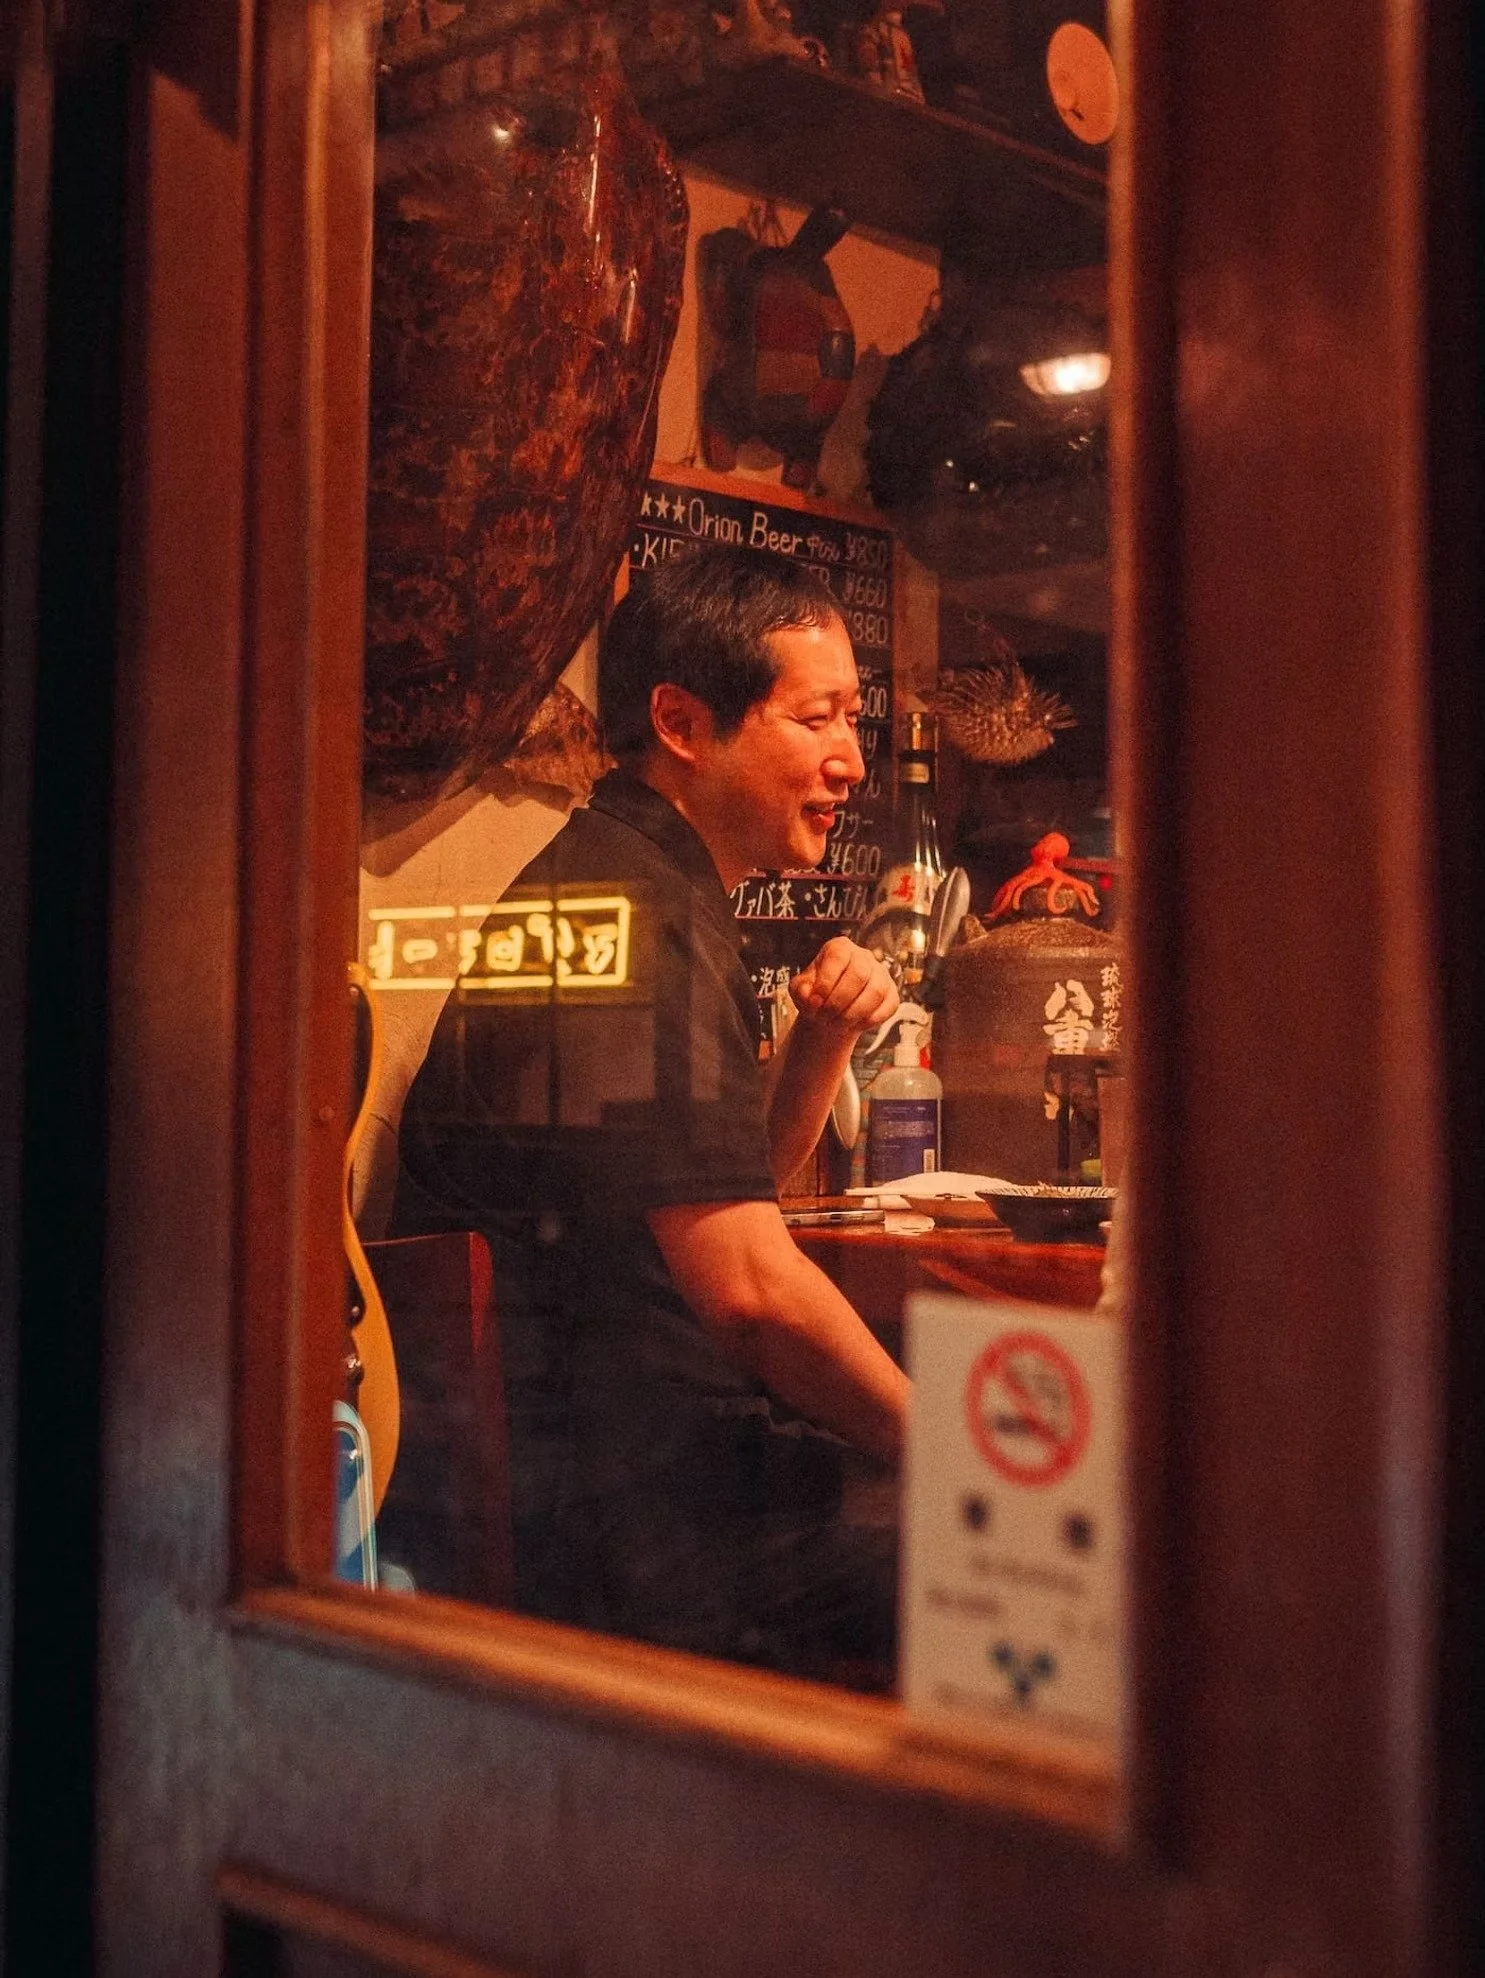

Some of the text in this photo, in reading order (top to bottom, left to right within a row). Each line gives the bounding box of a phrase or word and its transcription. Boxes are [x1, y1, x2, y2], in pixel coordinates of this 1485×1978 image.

[688, 497, 743, 545] Orion
[749, 511, 803, 555] Beer
[827, 842, 880, 876] ¥600
[1042, 978, 1095, 1121] 八重
